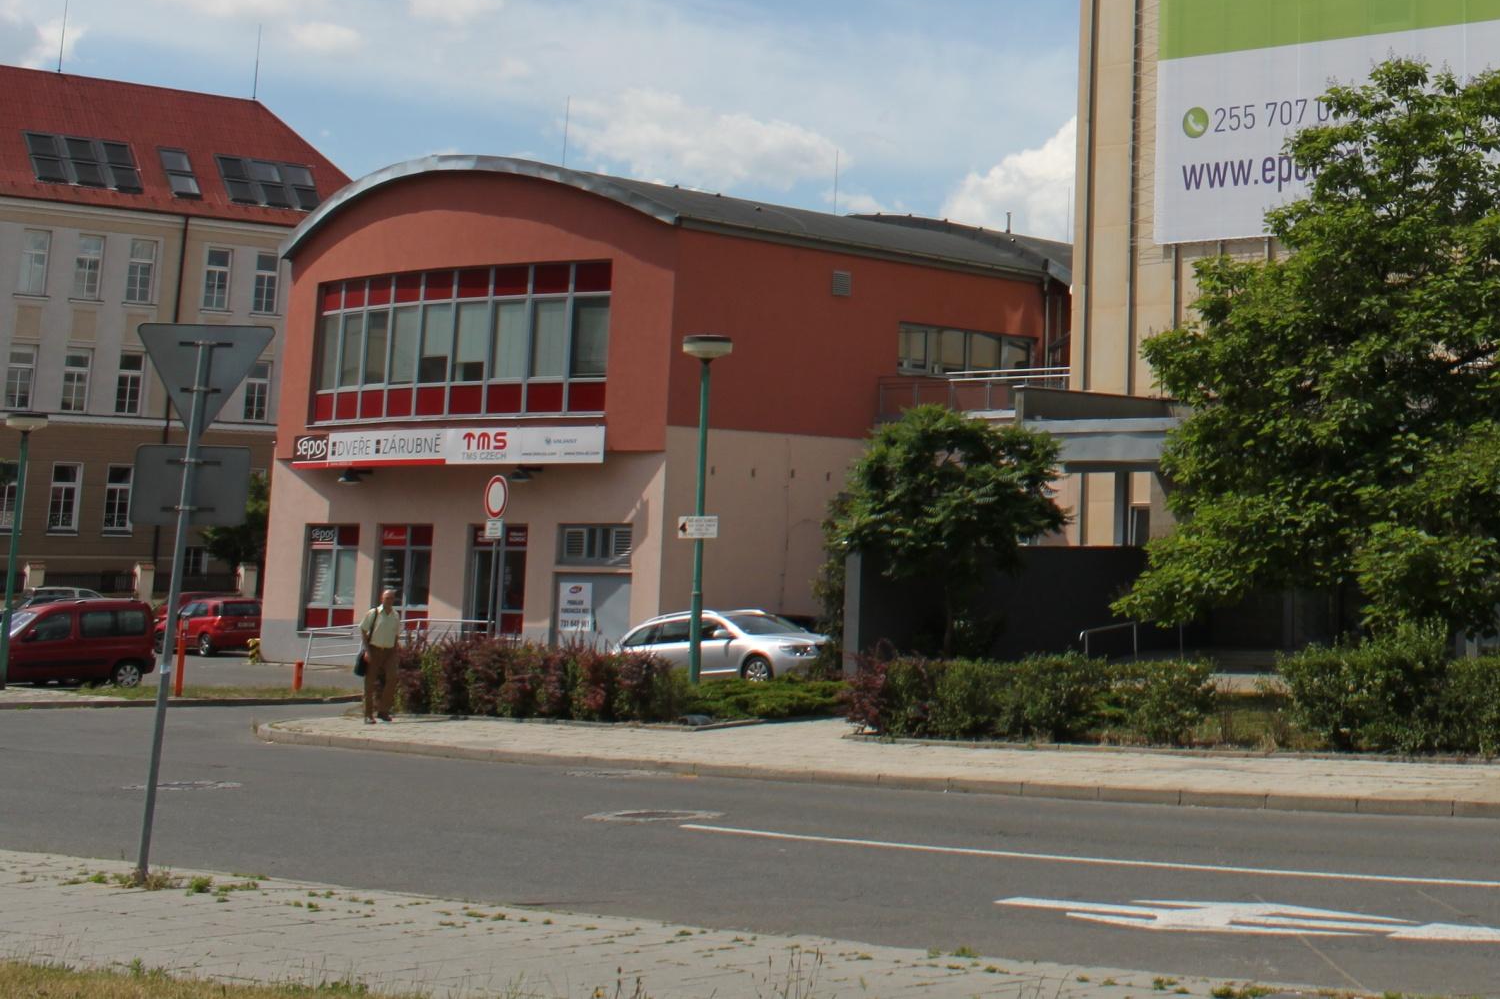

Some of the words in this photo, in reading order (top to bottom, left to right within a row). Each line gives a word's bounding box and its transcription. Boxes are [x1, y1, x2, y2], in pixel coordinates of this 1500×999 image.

[1214, 104, 1256, 133] 255
[1265, 98, 1307, 127] 707
[337, 436, 370, 457] DVEŘE
[381, 434, 441, 455] ZÁRUBNĚ
[462, 432, 507, 450] TMS
[461, 452, 478, 461] TMS
[479, 451, 507, 460] CZECH
